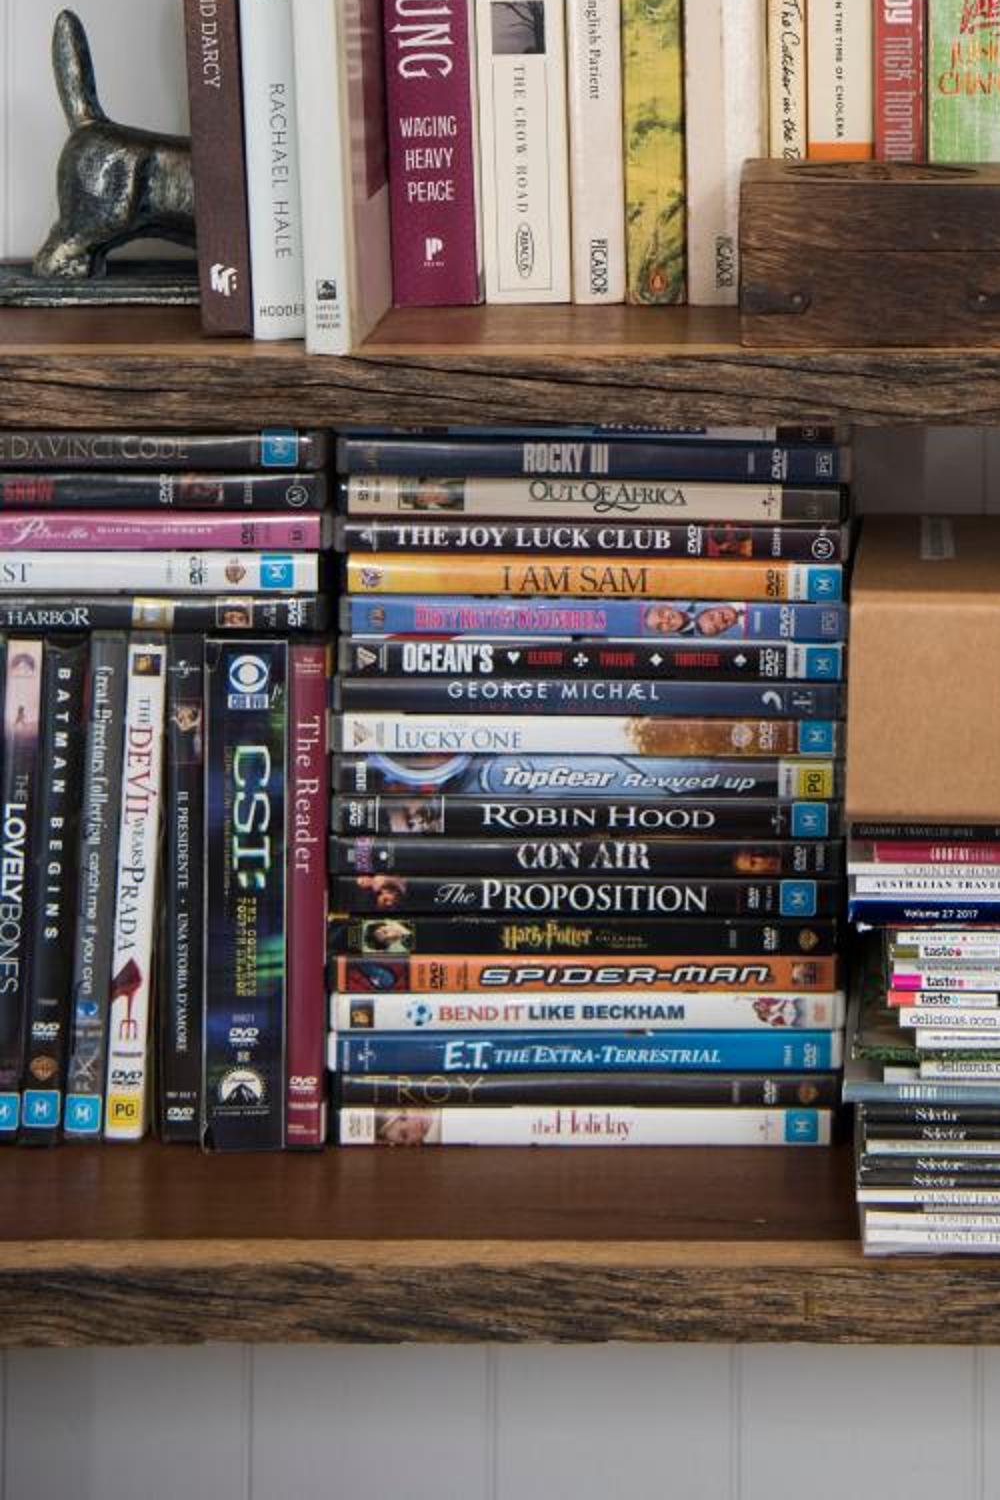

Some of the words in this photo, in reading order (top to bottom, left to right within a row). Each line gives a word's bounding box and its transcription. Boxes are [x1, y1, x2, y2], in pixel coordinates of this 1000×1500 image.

[200, 22, 220, 89] DARCY
[884, 36, 914, 80] nick
[587, 47, 602, 101] Patient
[267, 82, 292, 190] RACHAEL
[397, 115, 458, 138] WAGING
[402, 147, 455, 168] HEAVY
[405, 181, 455, 201] PEACE
[270, 200, 293, 259] HALE
[590, 237, 609, 296] PICADOR
[522, 442, 584, 473] ROCKY
[589, 442, 609, 473] III
[528, 479, 577, 504] OUT
[582, 480, 614, 513] OF
[615, 482, 687, 506] AFRICA
[393, 527, 447, 546] THE
[454, 526, 507, 549] JOY
[516, 527, 590, 548] LUCK
[596, 528, 671, 549] CLUB
[501, 565, 512, 593] I
[519, 565, 573, 593] AM
[578, 566, 651, 594] SAM
[6, 605, 90, 626] HARBOR
[402, 642, 494, 673] OCEAN'S
[137, 696, 152, 724] THE
[52, 668, 71, 794] BATMAN
[295, 714, 319, 768] The
[394, 723, 467, 749] LUCKY
[470, 730, 523, 749] ONE
[125, 725, 158, 826] DEVIL
[501, 765, 615, 789] TopGear
[623, 771, 723, 788] Revved
[729, 775, 756, 792] up
[231, 744, 272, 891] CSI:
[293, 783, 318, 876] Reader
[482, 803, 600, 829] ROBIN
[606, 806, 716, 830] HOOD
[129, 816, 146, 869] WEARS
[518, 842, 590, 869] CON
[595, 843, 651, 870] AIR
[45, 816, 63, 941] BEGINS
[874, 880, 954, 890] AUSTRALIAN
[116, 866, 147, 953] PRADA
[434, 882, 477, 904] The
[479, 880, 709, 912] PROPOSITION
[904, 908, 940, 919] Volume
[942, 908, 954, 919] 27
[956, 908, 979, 919] 2017
[499, 924, 543, 951] Harry
[542, 922, 592, 948] Potter
[479, 963, 772, 988] SPIDER-MAN
[438, 1005, 498, 1022] BEND
[502, 1005, 526, 1022] IT
[528, 1004, 576, 1022] LIKE
[581, 1004, 686, 1021] BECKHAM
[920, 992, 951, 1005] taste
[443, 1040, 490, 1070] E.T.
[494, 1047, 532, 1063] THE
[534, 1044, 721, 1066] EXTRA-TERRESTRIAL
[115, 1103, 136, 1116] PG
[554, 1110, 634, 1140] Holiday
